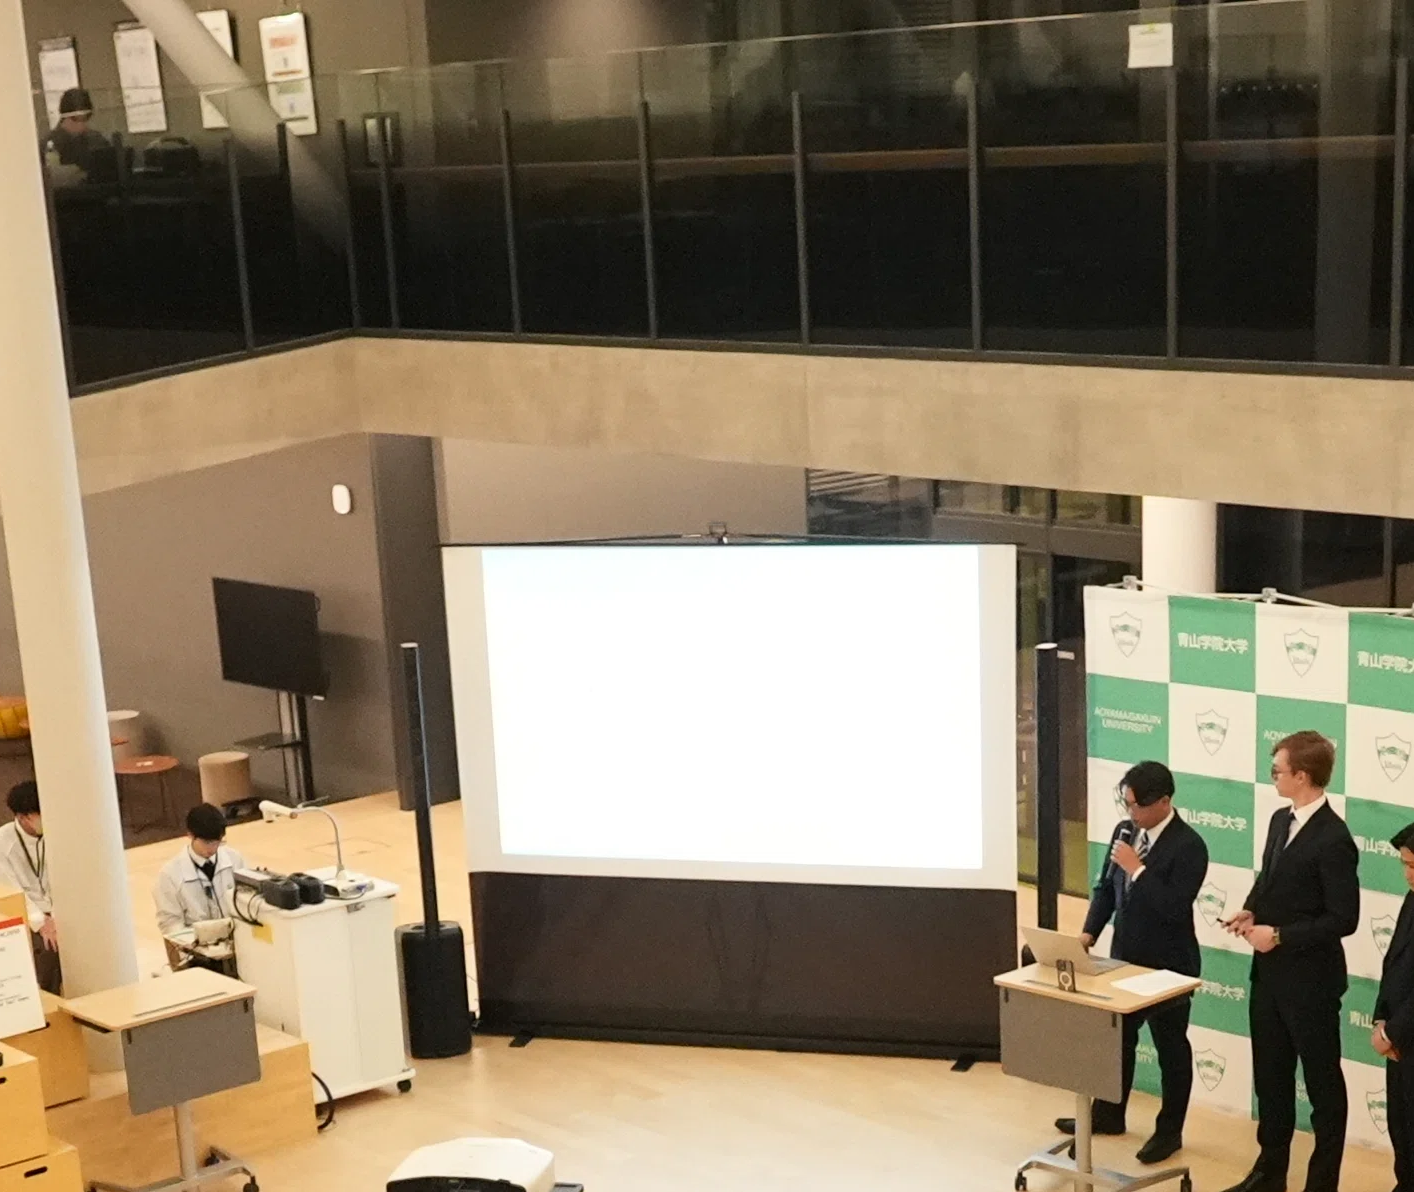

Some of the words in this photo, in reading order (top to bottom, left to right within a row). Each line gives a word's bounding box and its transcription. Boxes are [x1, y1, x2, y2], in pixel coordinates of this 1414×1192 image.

[1178, 632, 1248, 655] 青山学院大学
[1101, 717, 1154, 733] UNIVERSITY
